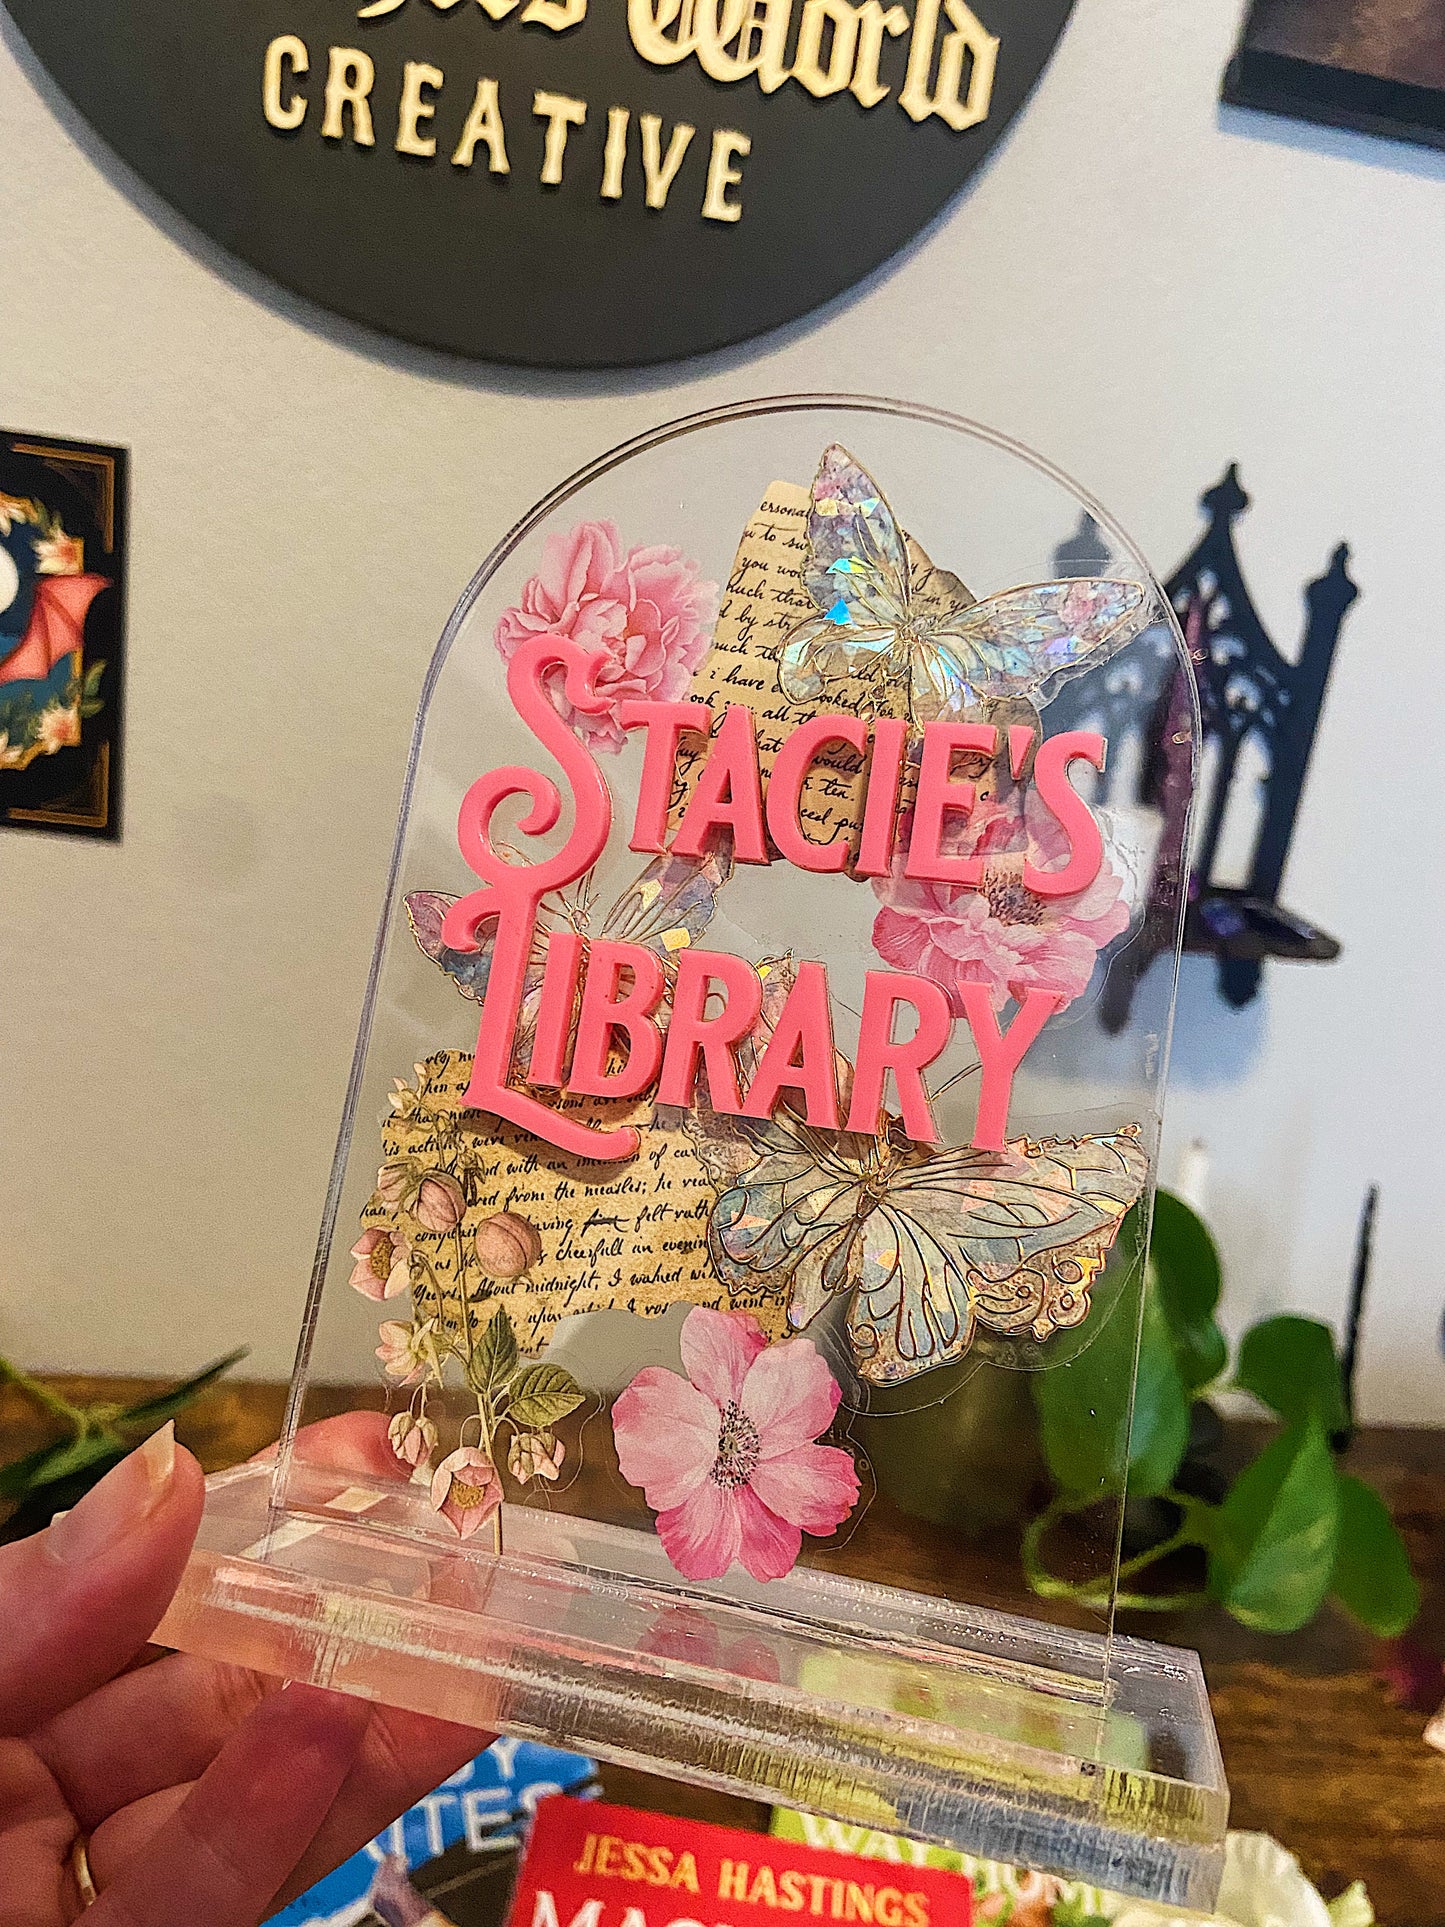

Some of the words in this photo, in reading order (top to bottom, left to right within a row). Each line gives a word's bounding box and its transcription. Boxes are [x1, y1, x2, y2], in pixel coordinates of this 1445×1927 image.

[627, 0, 1000, 131] World
[262, 34, 752, 223] CREATIVE
[722, 665, 765, 690] have
[762, 705, 791, 721] all
[457, 634, 1105, 899] STACIE'S
[441, 882, 1066, 1161] LIBRARY
[507, 1153, 539, 1175] with
[649, 1143, 668, 1170] of
[554, 1181, 576, 1201] the
[634, 1202, 674, 1233] felt
[675, 1198, 711, 1222] rath
[573, 1832, 701, 1893] JESSA
[717, 1857, 931, 1927] HASTINGS
